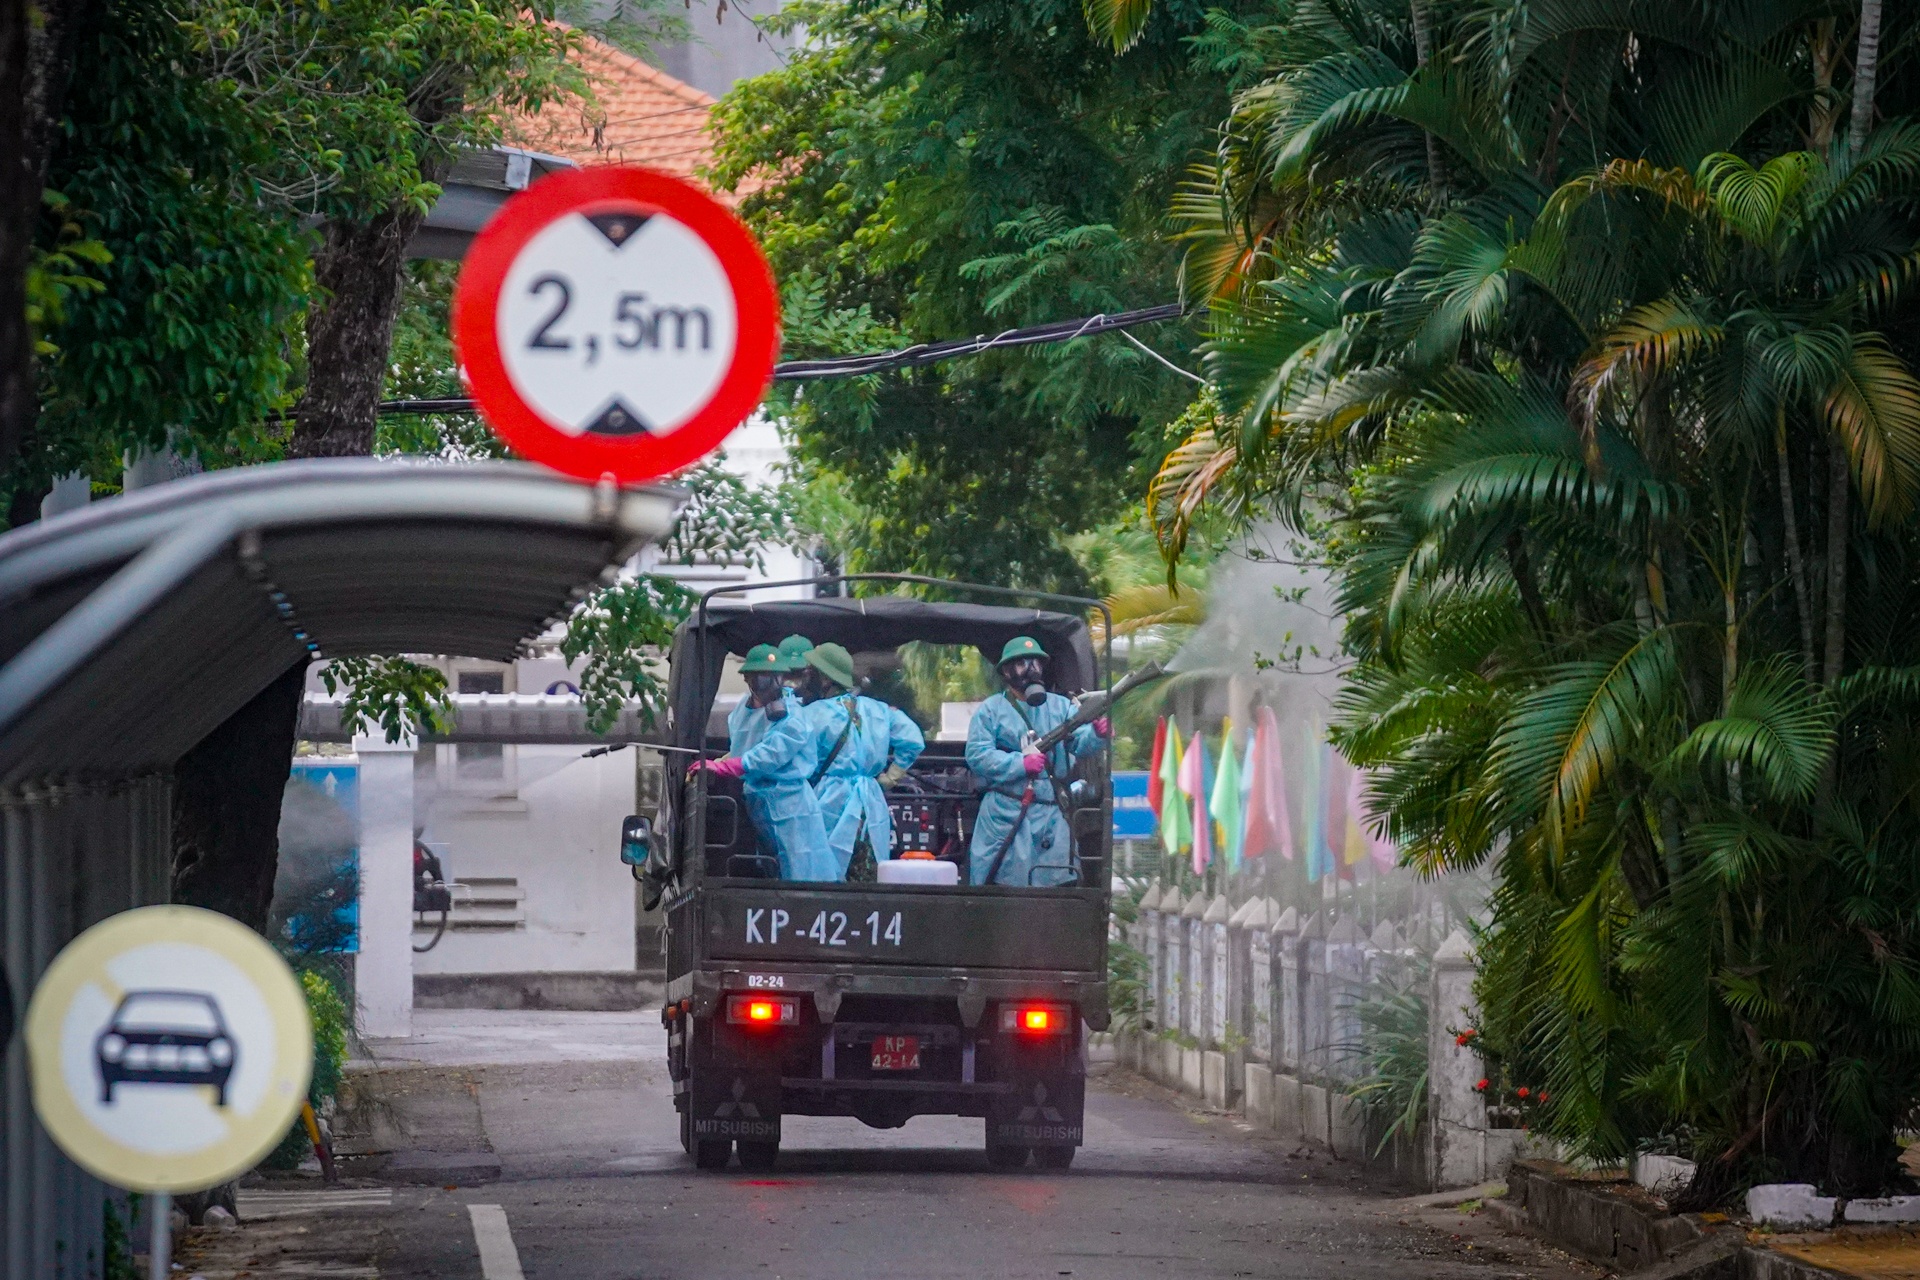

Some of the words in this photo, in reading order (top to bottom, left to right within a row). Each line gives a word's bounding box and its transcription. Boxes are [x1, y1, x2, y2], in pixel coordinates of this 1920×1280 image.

[527, 271, 712, 366] 2,5m
[746, 908, 902, 946] KP-42-14
[748, 974, 784, 988] 02-24
[885, 1036, 905, 1053] KP
[872, 1053, 920, 1069] 42-14
[695, 1119, 779, 1135] MITSUBISHI
